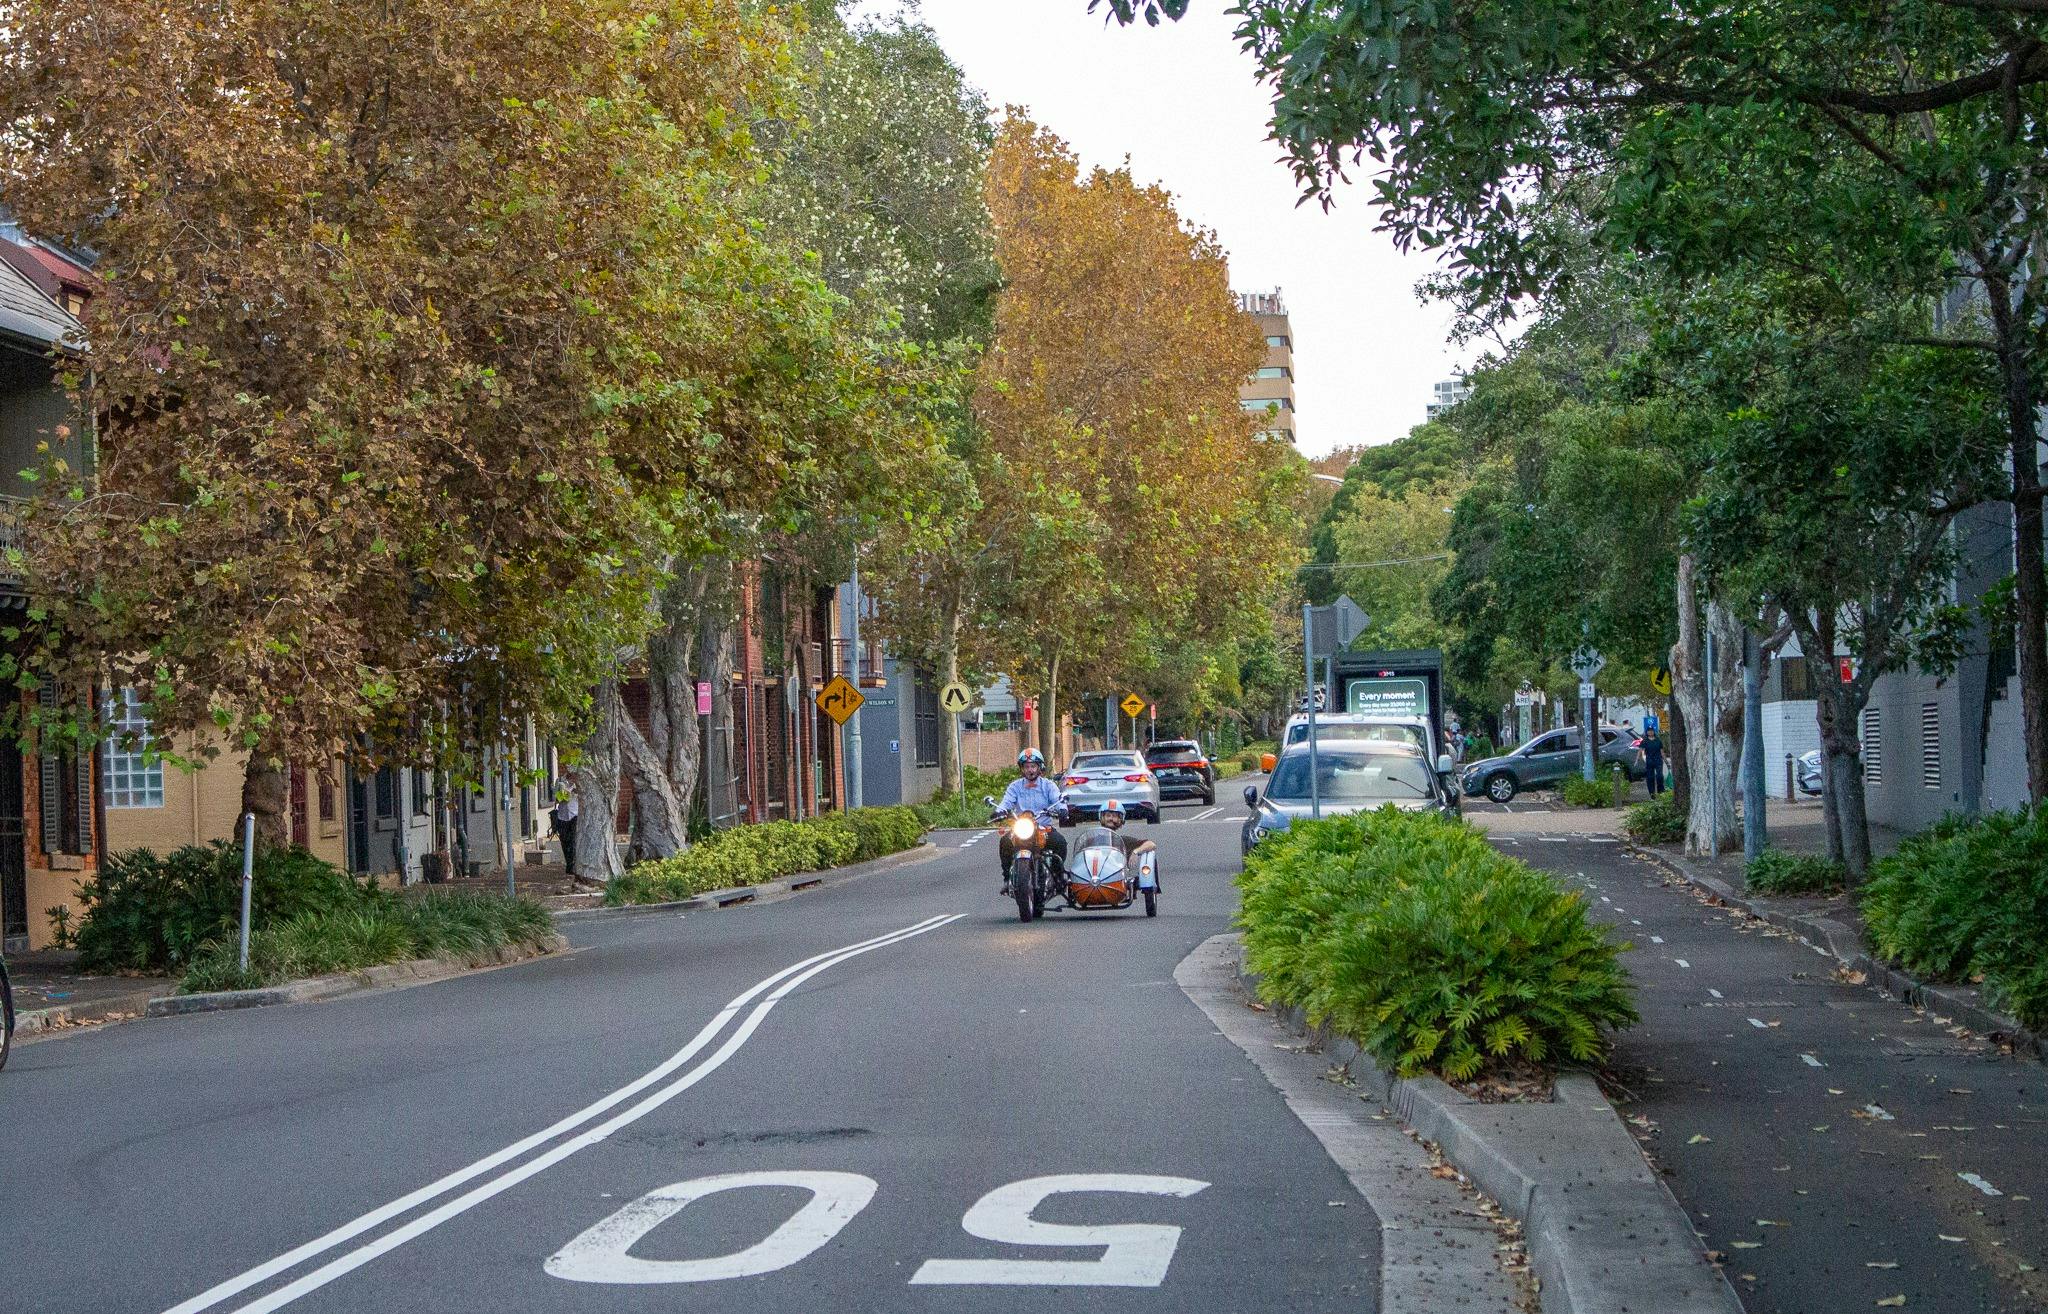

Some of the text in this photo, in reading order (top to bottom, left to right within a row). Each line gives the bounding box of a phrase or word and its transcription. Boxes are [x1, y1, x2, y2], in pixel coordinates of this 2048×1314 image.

[1360, 691, 1415, 701] Every moment
[543, 1170, 1212, 1287] 50
